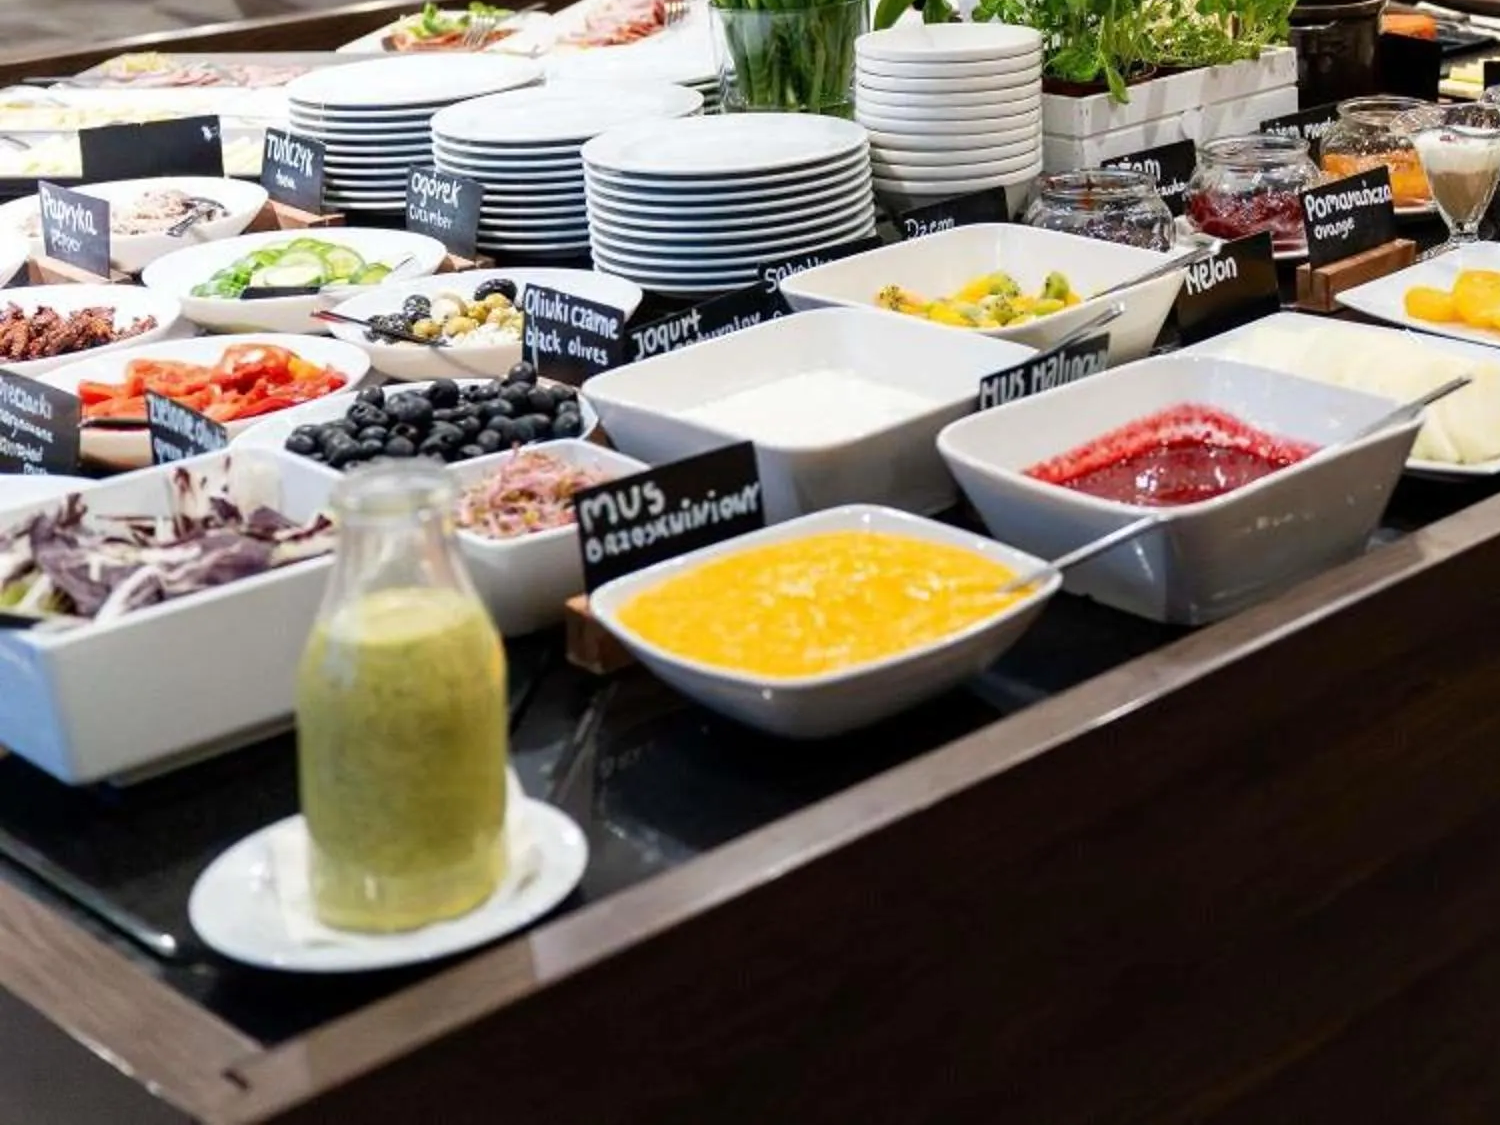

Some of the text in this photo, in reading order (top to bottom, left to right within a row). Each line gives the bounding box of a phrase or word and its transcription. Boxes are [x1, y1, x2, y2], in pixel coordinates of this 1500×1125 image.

[1304, 180, 1393, 222] Pomarańcza
[1314, 217, 1355, 240] orange
[579, 480, 666, 534] MUS
